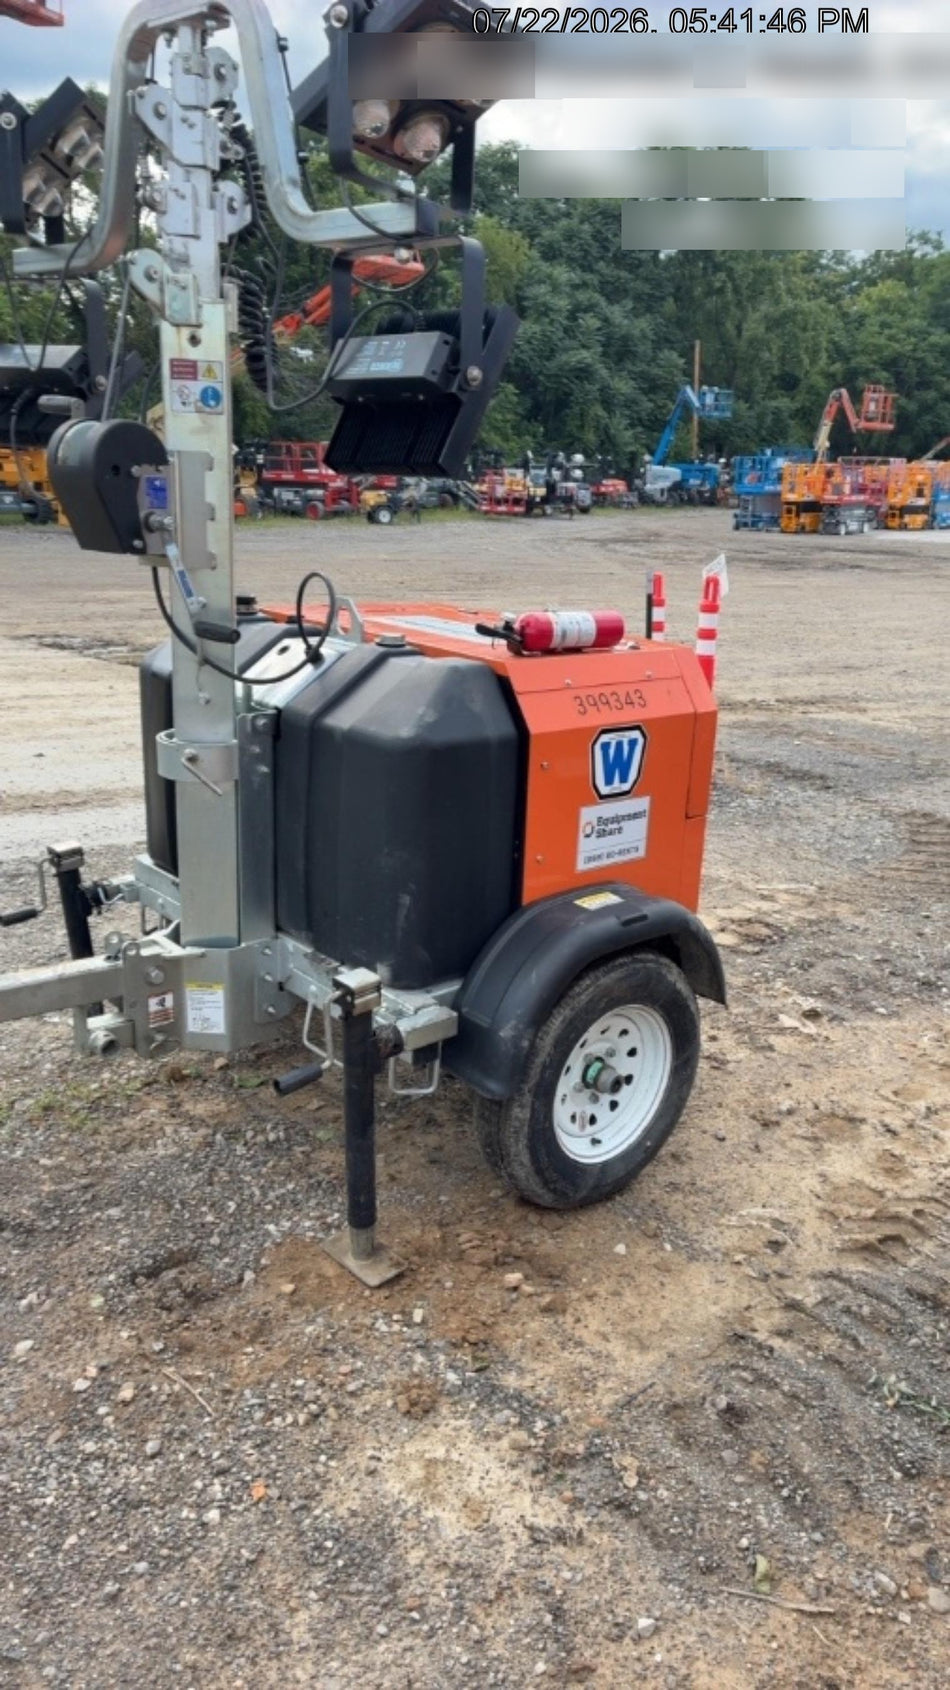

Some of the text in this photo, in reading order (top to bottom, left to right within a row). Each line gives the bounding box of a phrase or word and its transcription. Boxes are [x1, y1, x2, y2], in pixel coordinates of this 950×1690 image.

[573, 688, 647, 716] 399343
[600, 737, 639, 787] W
[597, 809, 647, 827] Equipment
[596, 826, 623, 839] Share
